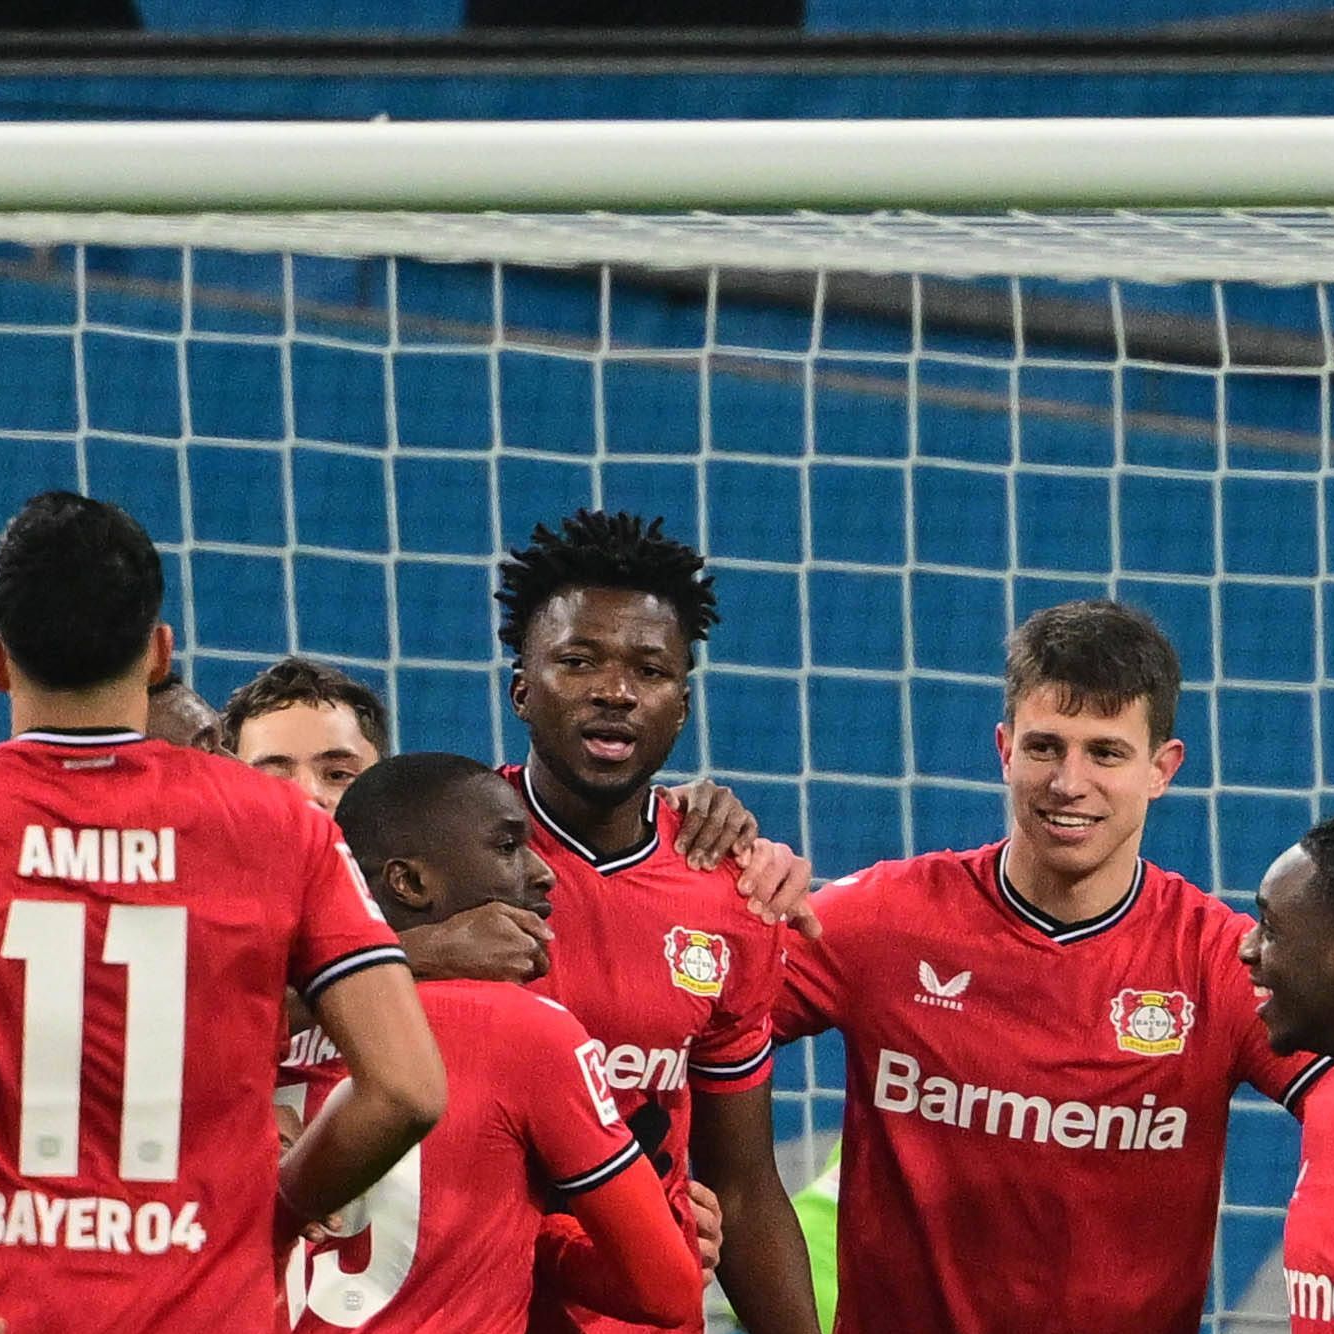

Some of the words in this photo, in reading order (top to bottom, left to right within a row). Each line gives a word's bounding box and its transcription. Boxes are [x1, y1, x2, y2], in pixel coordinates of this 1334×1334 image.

[18, 825, 177, 883] AMIRI
[0, 899, 188, 1182] 11
[873, 1047, 1188, 1151] Barmenia
